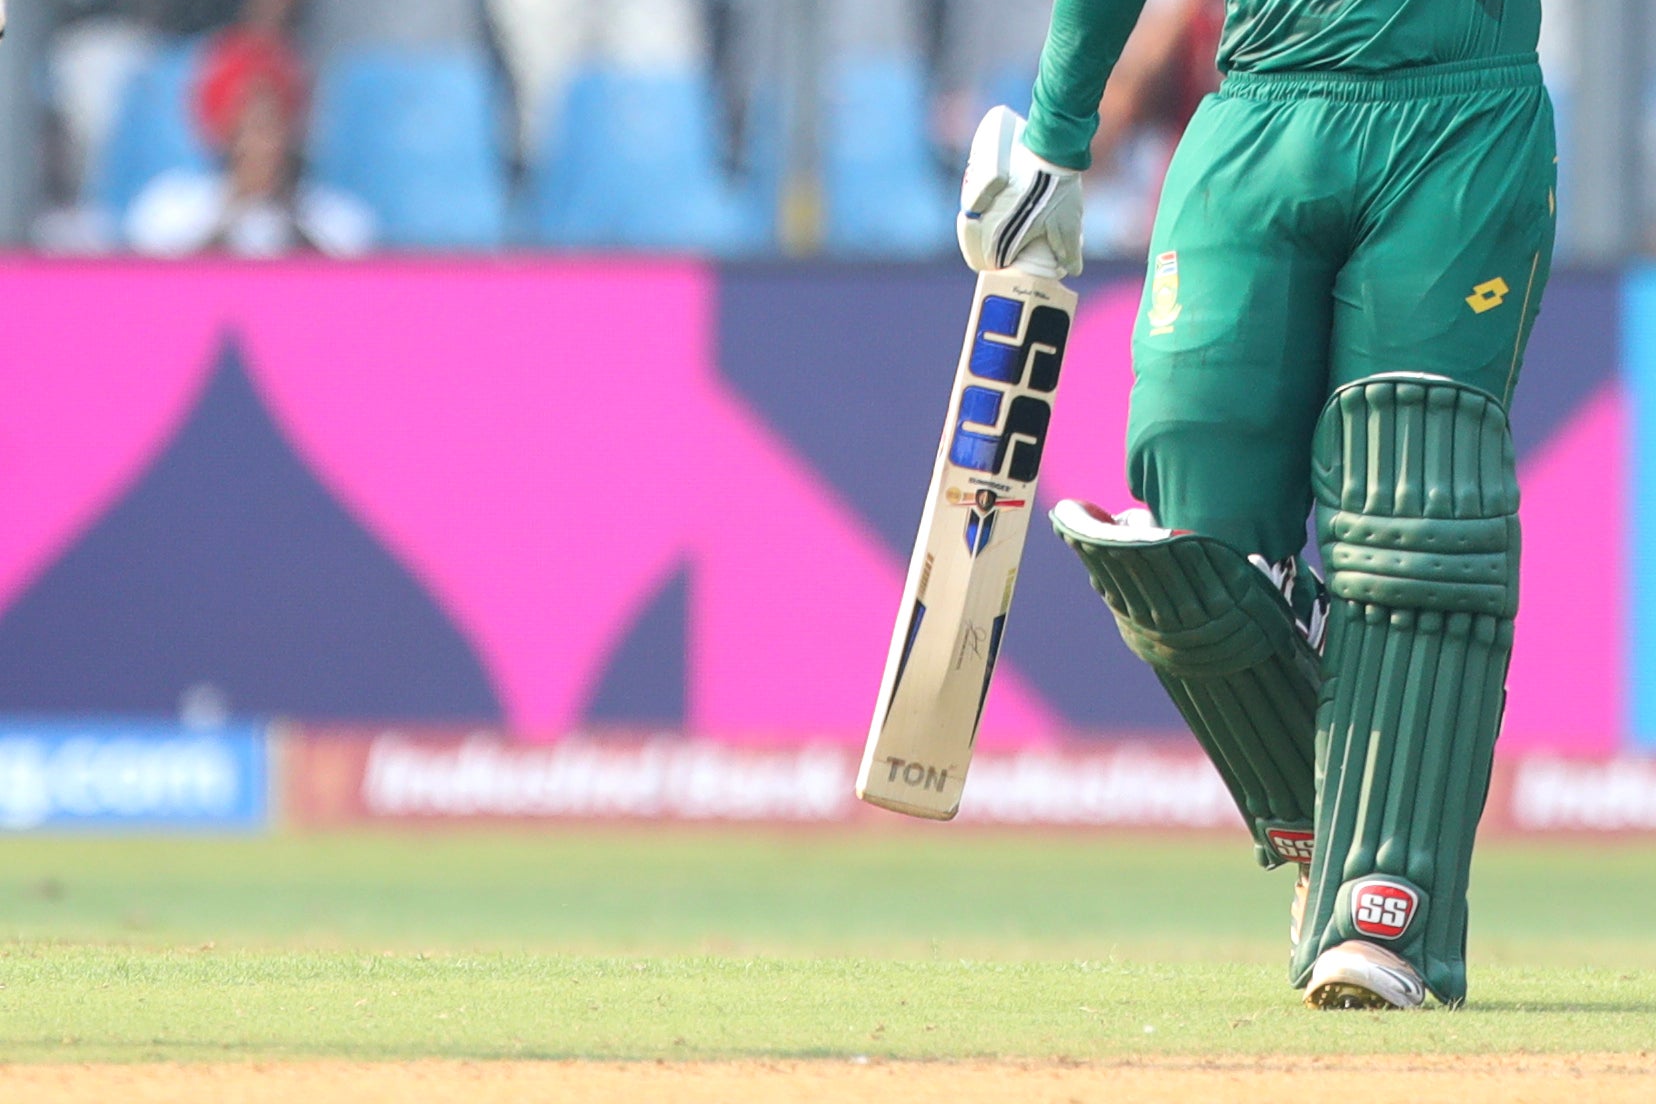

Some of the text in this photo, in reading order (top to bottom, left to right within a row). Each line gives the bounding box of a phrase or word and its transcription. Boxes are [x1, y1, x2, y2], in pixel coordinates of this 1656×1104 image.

[886, 755, 948, 793] TON
[1273, 835, 1315, 859] SS
[1357, 892, 1408, 928] SS
